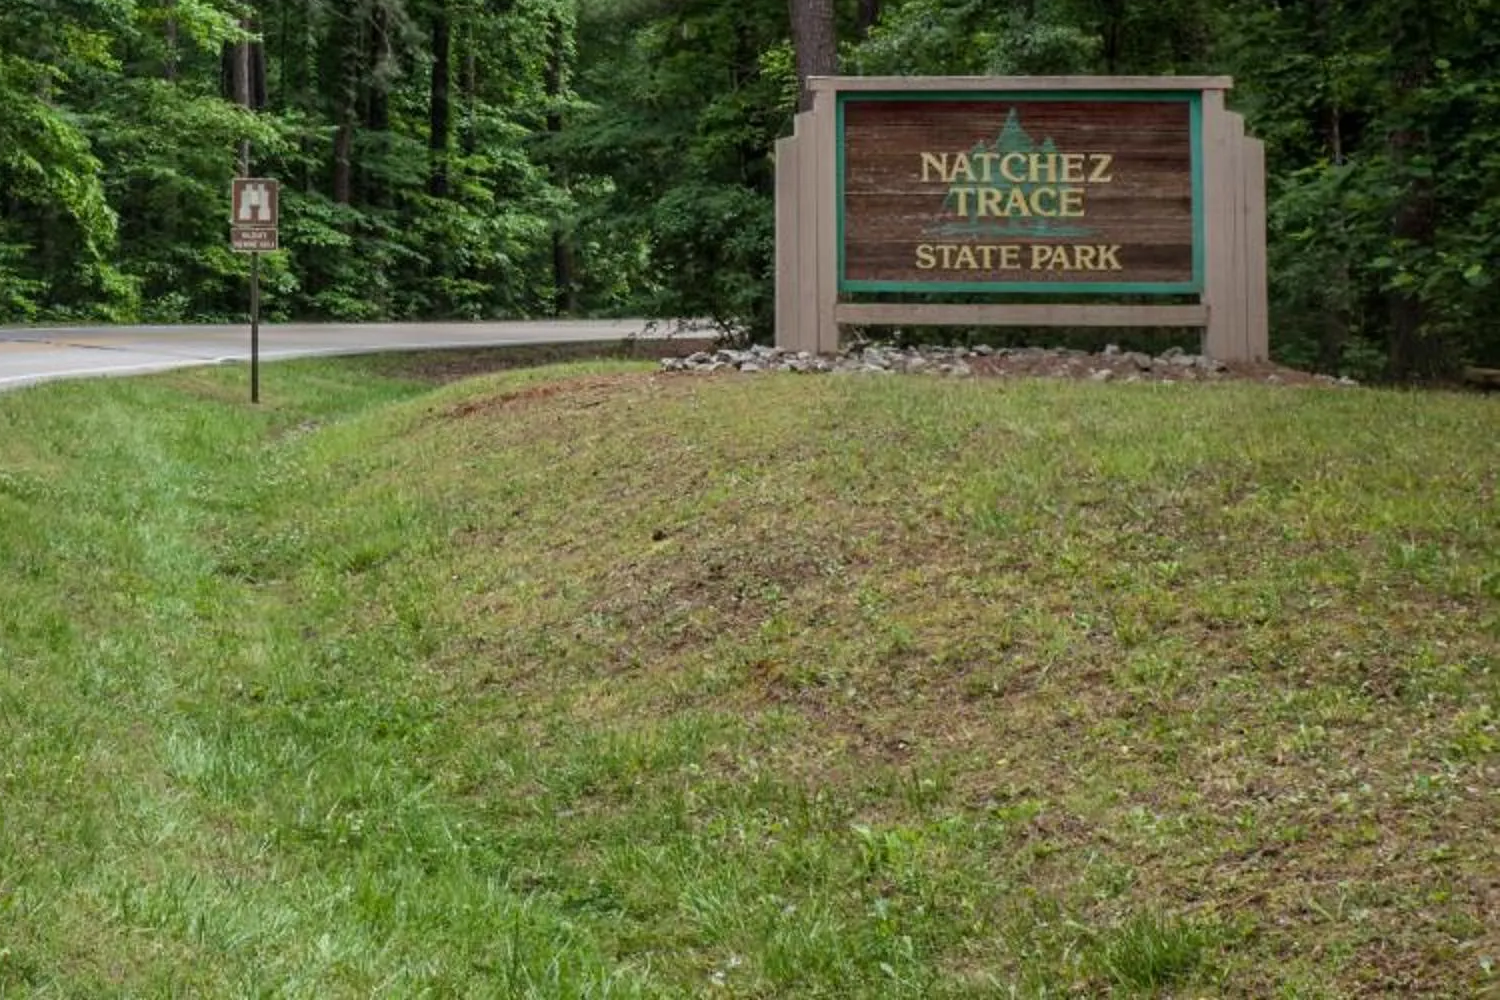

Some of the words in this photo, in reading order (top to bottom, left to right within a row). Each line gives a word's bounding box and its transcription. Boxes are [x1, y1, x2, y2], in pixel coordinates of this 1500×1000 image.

[920, 152, 1113, 183] NATCHEZ
[950, 187, 1085, 217] TRACE
[915, 244, 1021, 269] STATE
[1030, 245, 1122, 270] PARK
